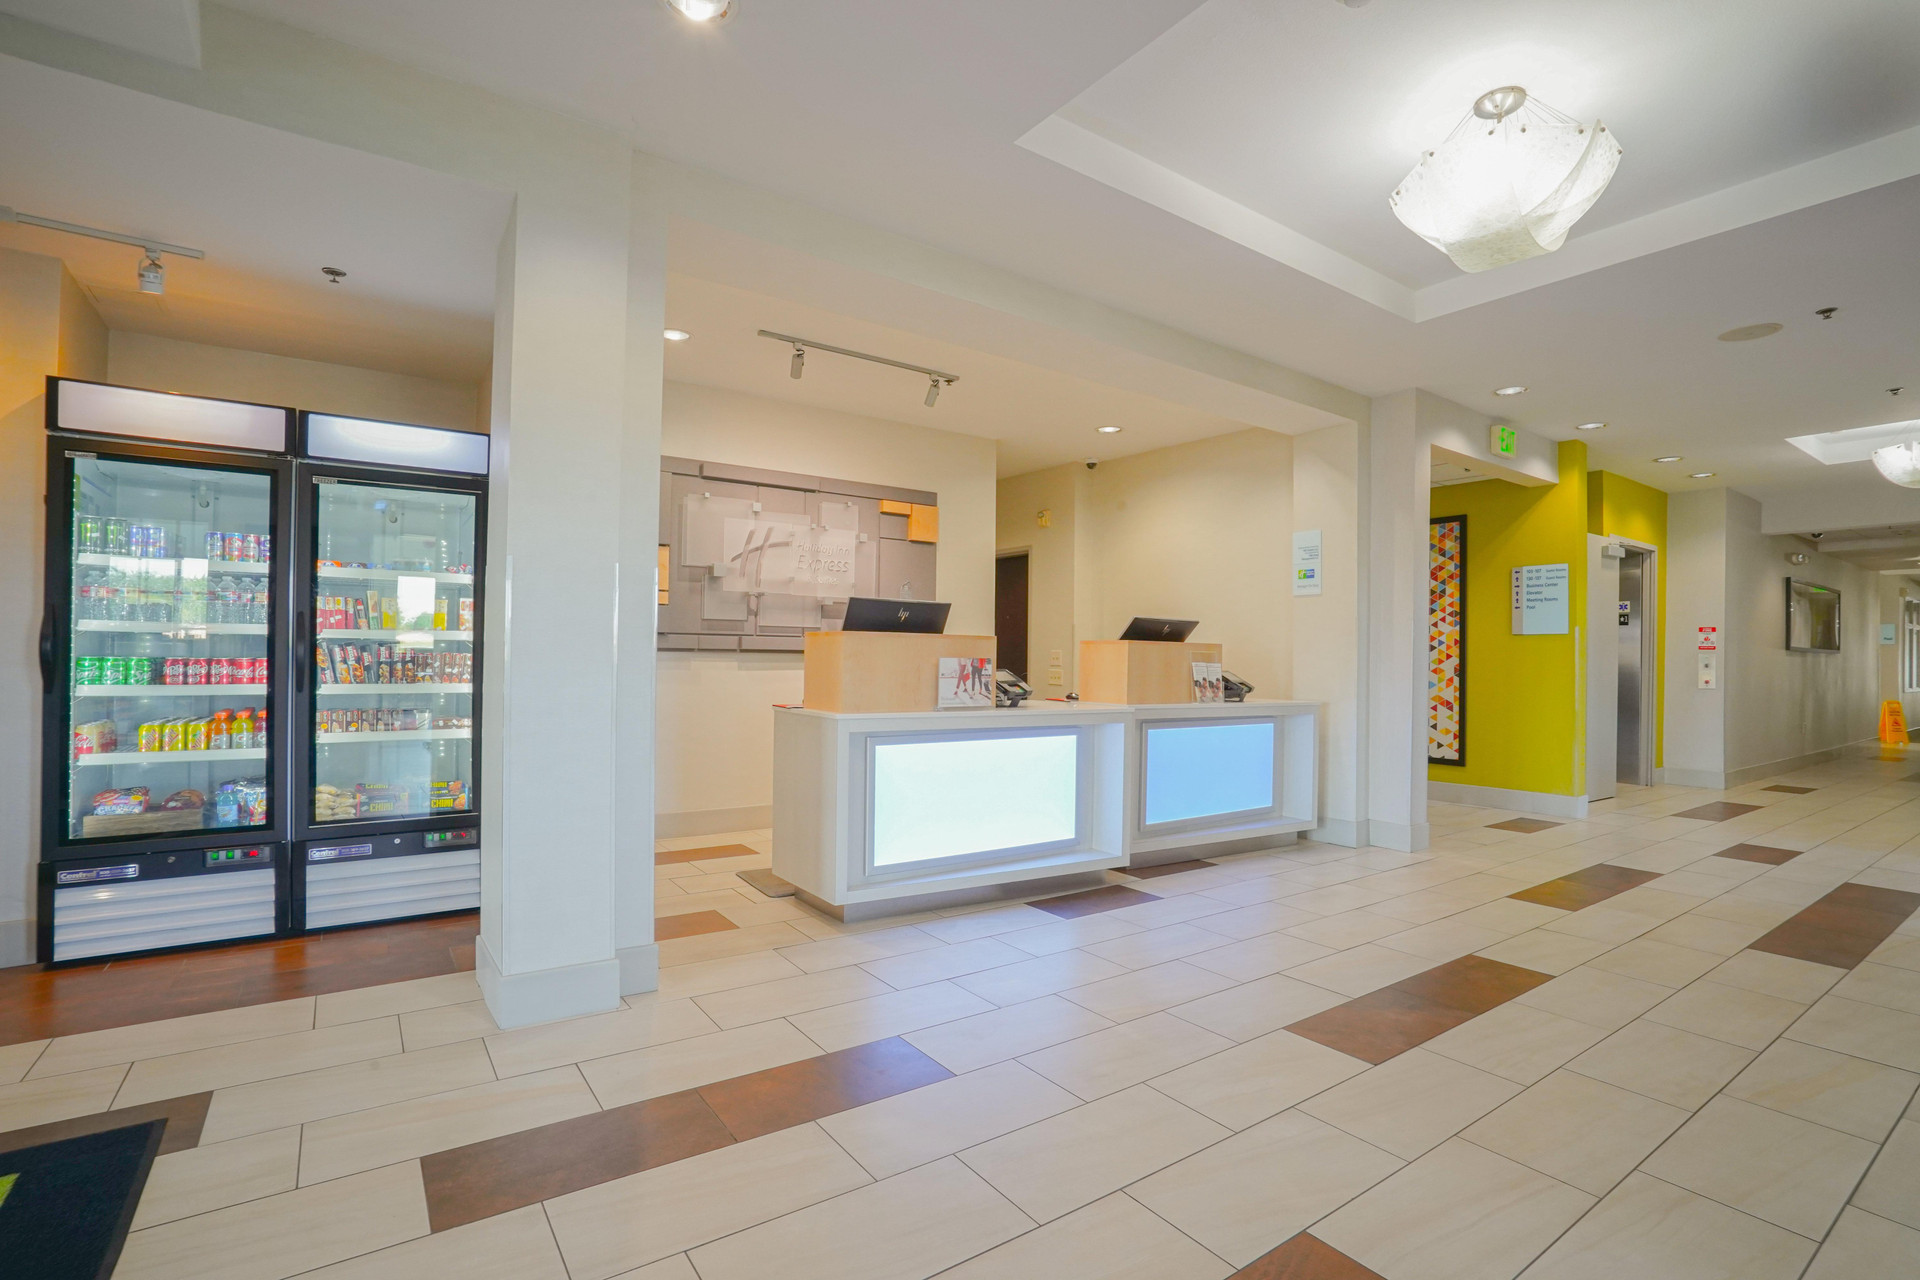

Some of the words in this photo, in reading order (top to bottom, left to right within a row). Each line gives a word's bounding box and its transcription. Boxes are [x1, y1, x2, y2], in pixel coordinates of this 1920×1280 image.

[797, 541, 834, 556] Holiday
[836, 544, 850, 556] Inn
[797, 554, 849, 574] Express
